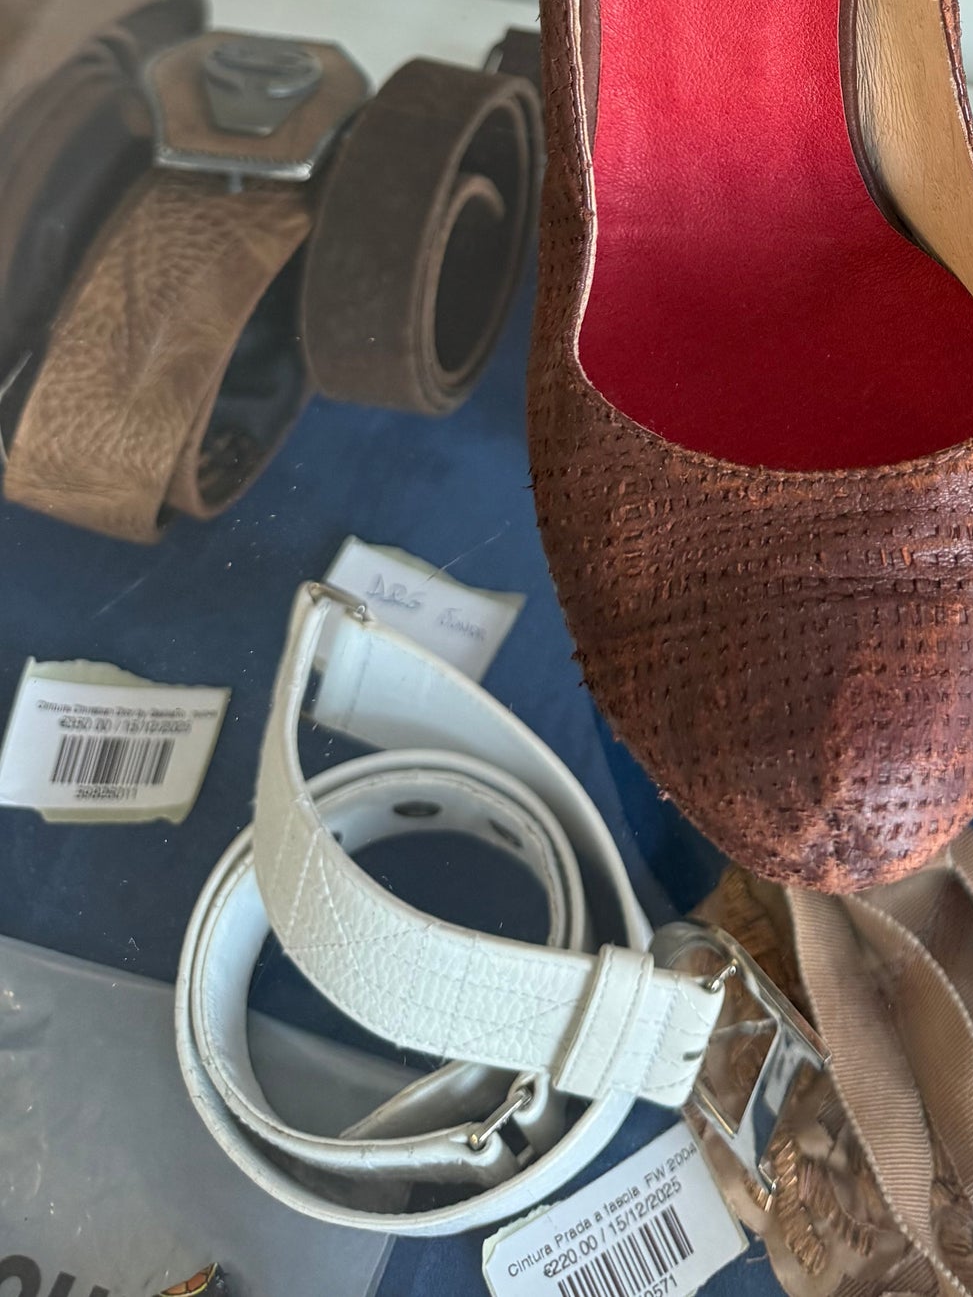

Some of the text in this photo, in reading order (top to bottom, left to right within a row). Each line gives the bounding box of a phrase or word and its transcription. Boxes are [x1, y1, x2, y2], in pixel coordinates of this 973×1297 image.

[507, 1243, 552, 1278] Cintura
[554, 1218, 593, 1248] Prada
[596, 1208, 604, 1221] a
[606, 1186, 640, 1215] fascia
[643, 1165, 667, 1190] FW
[543, 1235, 599, 1278] €220.00
[608, 1176, 683, 1237] 15/12/2025
